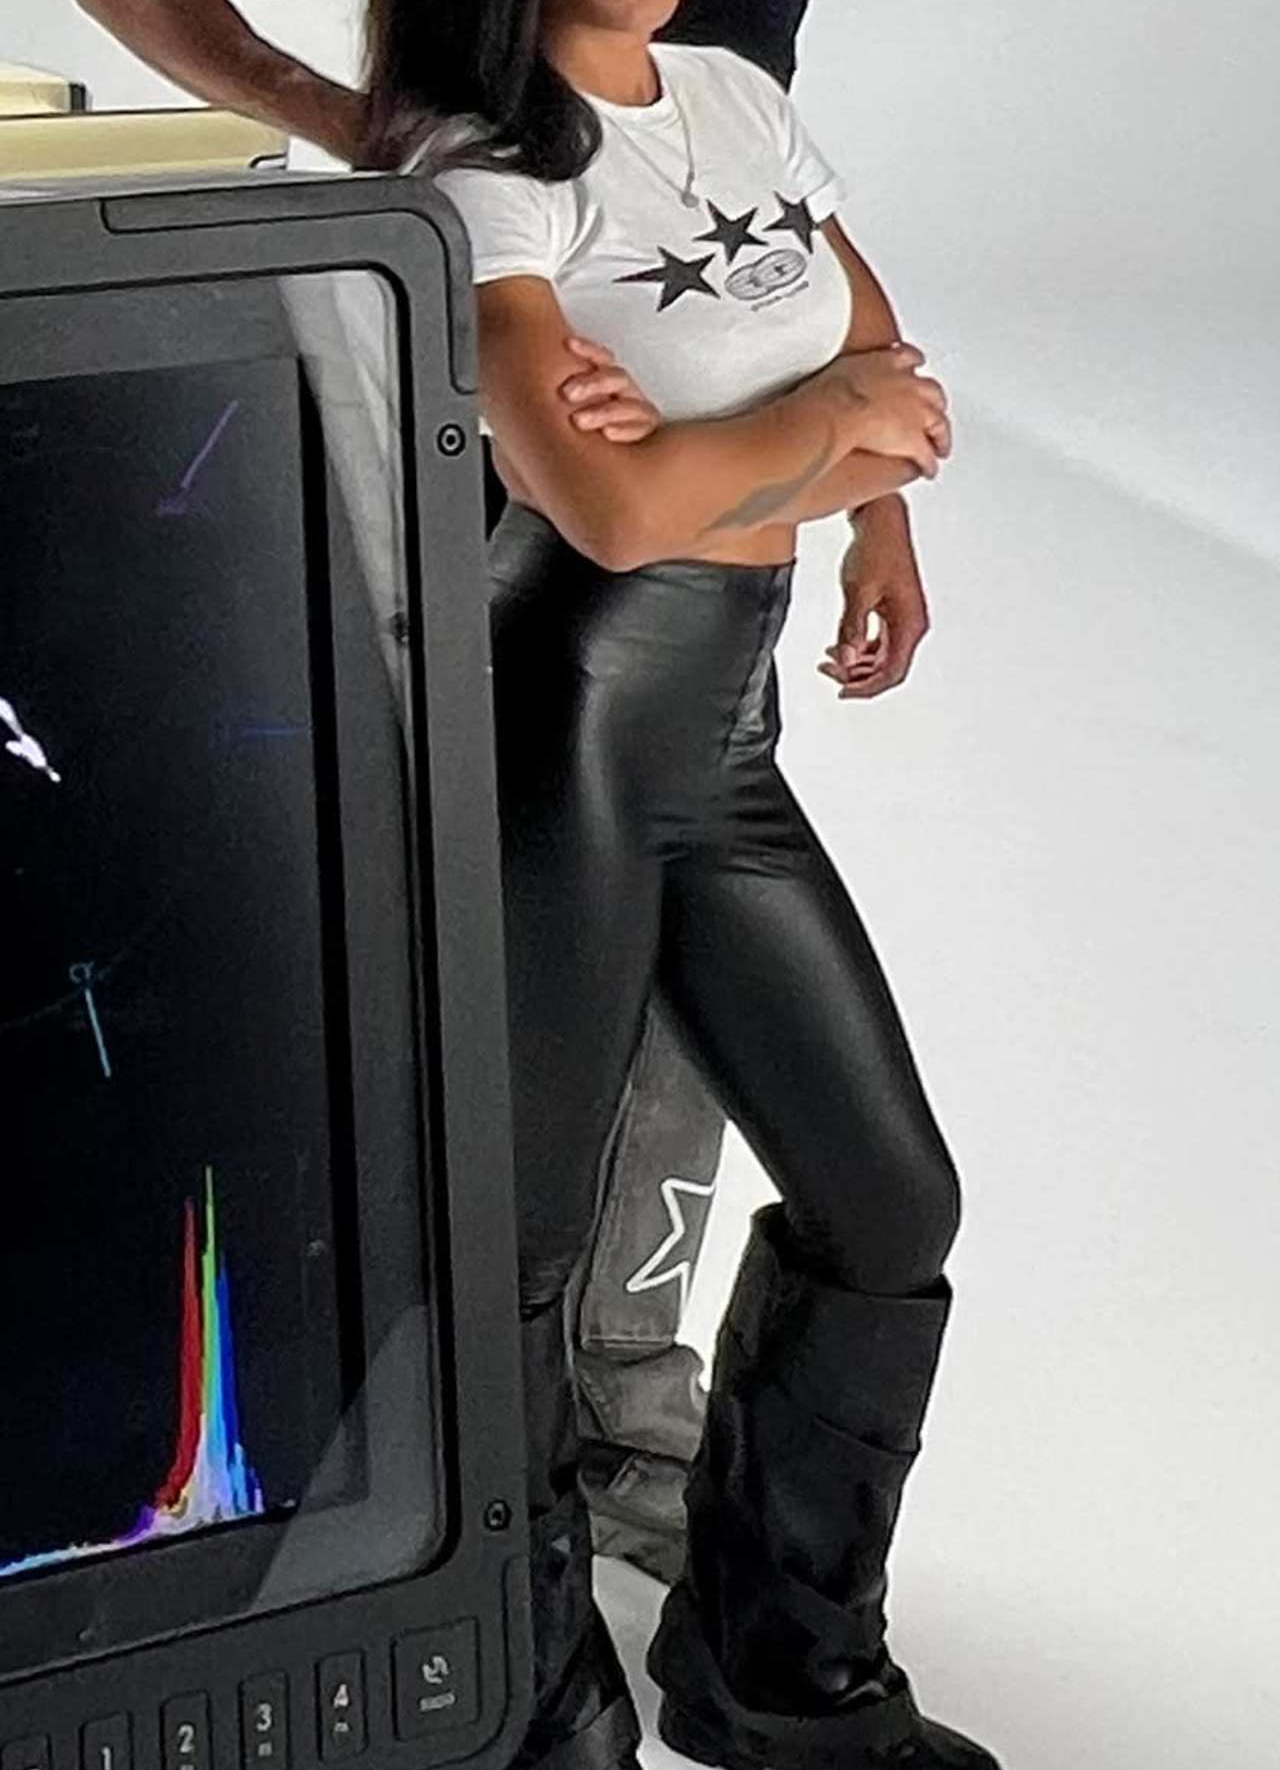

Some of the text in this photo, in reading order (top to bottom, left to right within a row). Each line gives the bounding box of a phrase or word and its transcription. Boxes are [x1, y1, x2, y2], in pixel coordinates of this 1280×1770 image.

[333, 1683, 350, 1708] 4
[256, 1703, 272, 1731] 3
[177, 1724, 195, 1753] 2
